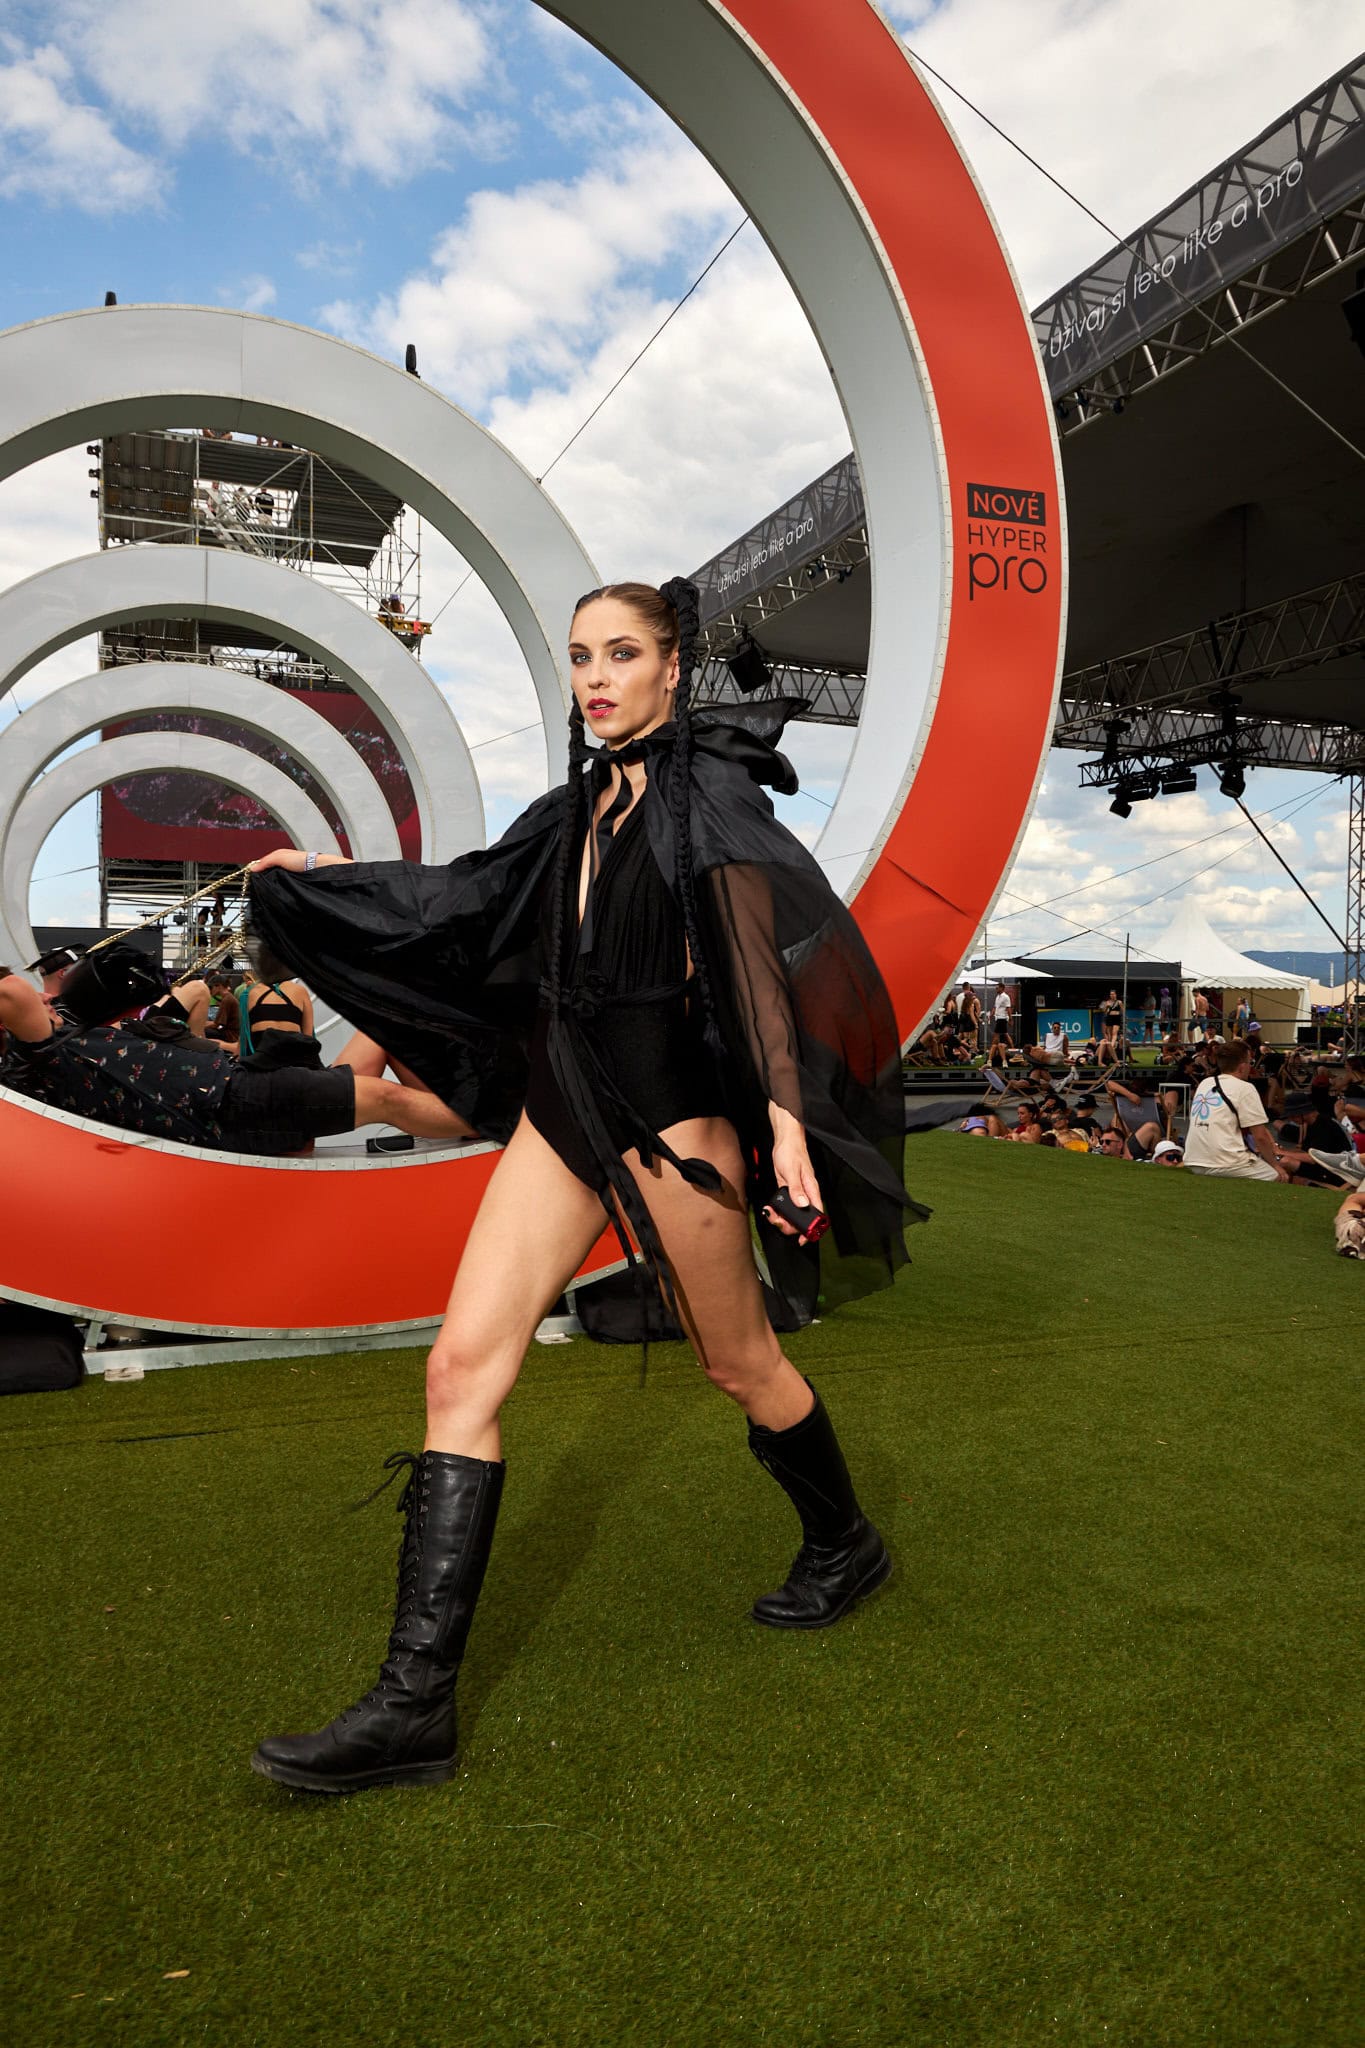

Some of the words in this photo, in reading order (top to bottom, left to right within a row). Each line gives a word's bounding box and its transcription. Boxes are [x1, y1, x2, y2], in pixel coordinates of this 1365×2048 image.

[1112, 282, 1126, 314] si
[1133, 255, 1176, 300] leto
[1183, 220, 1223, 265] like
[1231, 199, 1248, 228] a
[1256, 160, 1304, 219] pro
[973, 490, 1040, 519] NOVÉ
[741, 557, 748, 576] si
[751, 550, 767, 570] leto
[770, 537, 785, 559] like
[786, 531, 794, 545] a
[795, 518, 813, 544] pro
[968, 523, 1047, 553] HYPER
[968, 552, 1047, 601] pro
